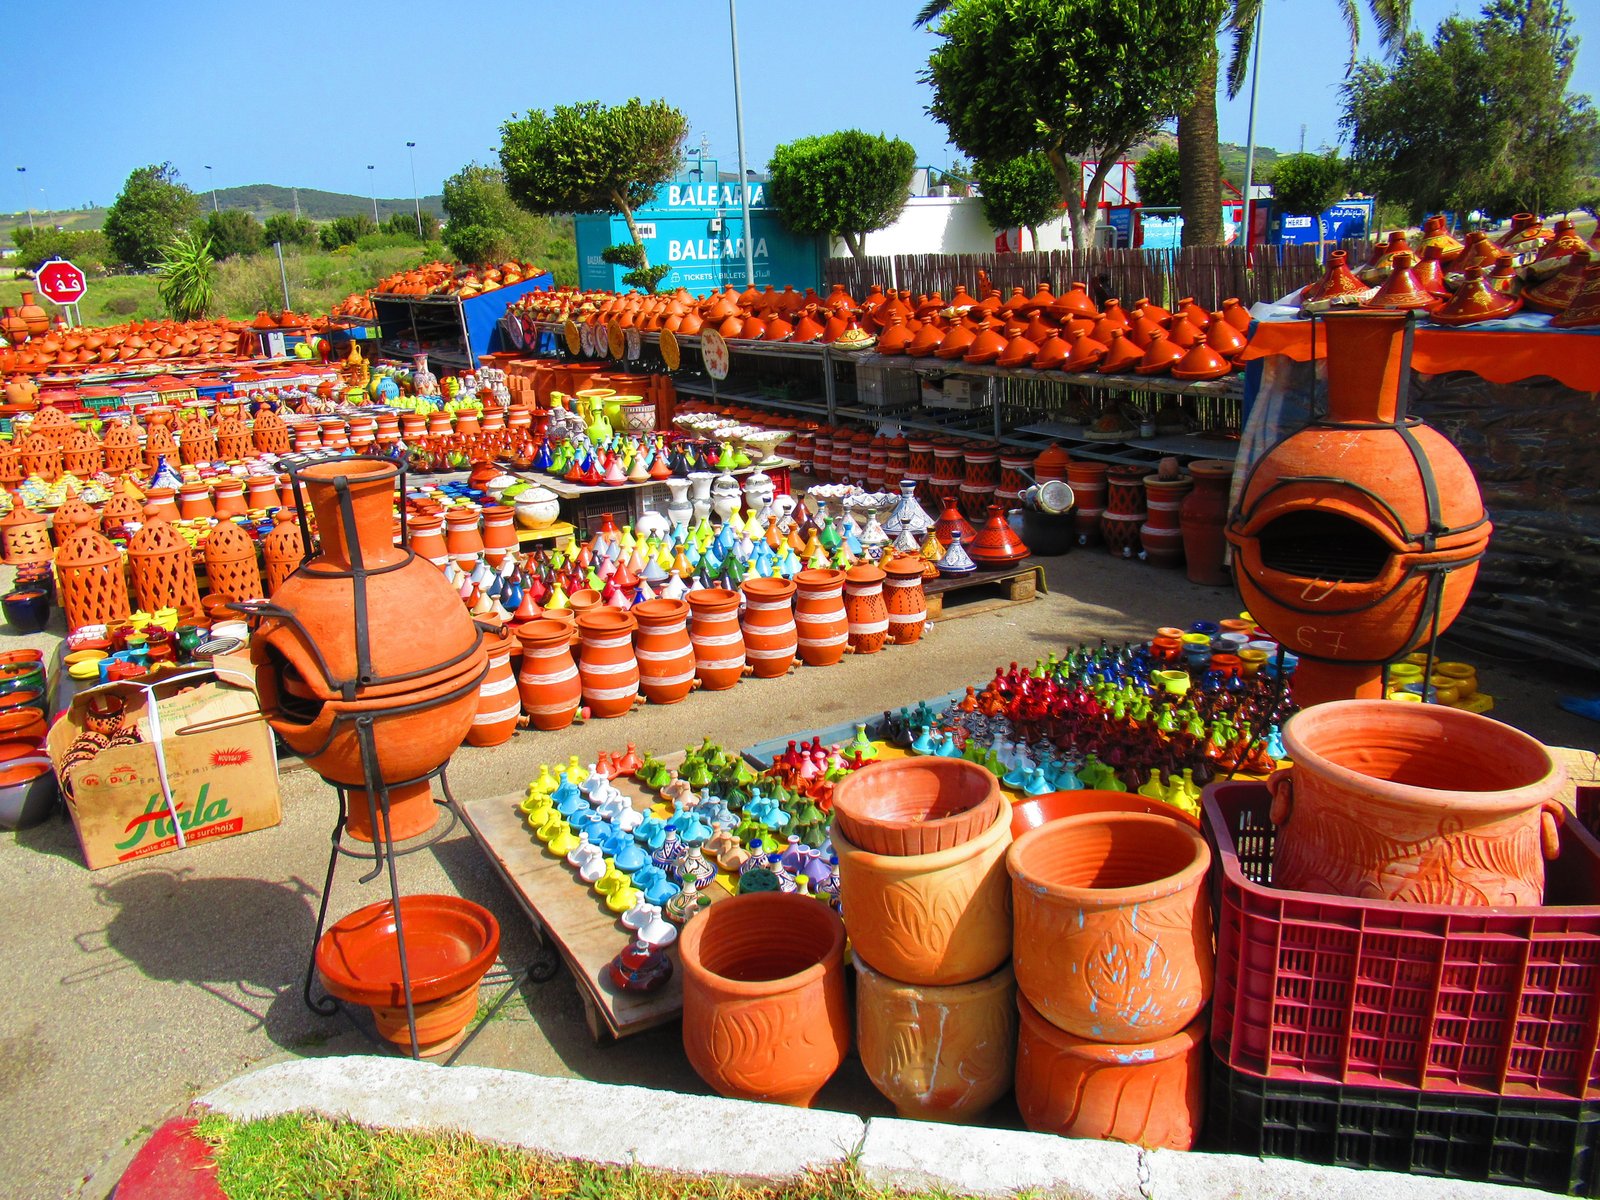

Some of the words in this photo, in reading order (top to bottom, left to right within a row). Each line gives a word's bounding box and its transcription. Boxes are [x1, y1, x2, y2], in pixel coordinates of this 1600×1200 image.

[669, 185, 766, 206] BALEARIA
[669, 237, 769, 261] BALEARA
[684, 273, 713, 281] TICKETS
[719, 271, 746, 279] BILLETS
[115, 783, 232, 850] Hala
[135, 844, 158, 856] Huile
[160, 840, 171, 848] de
[173, 832, 195, 845] tle
[196, 821, 234, 838] surchoix
